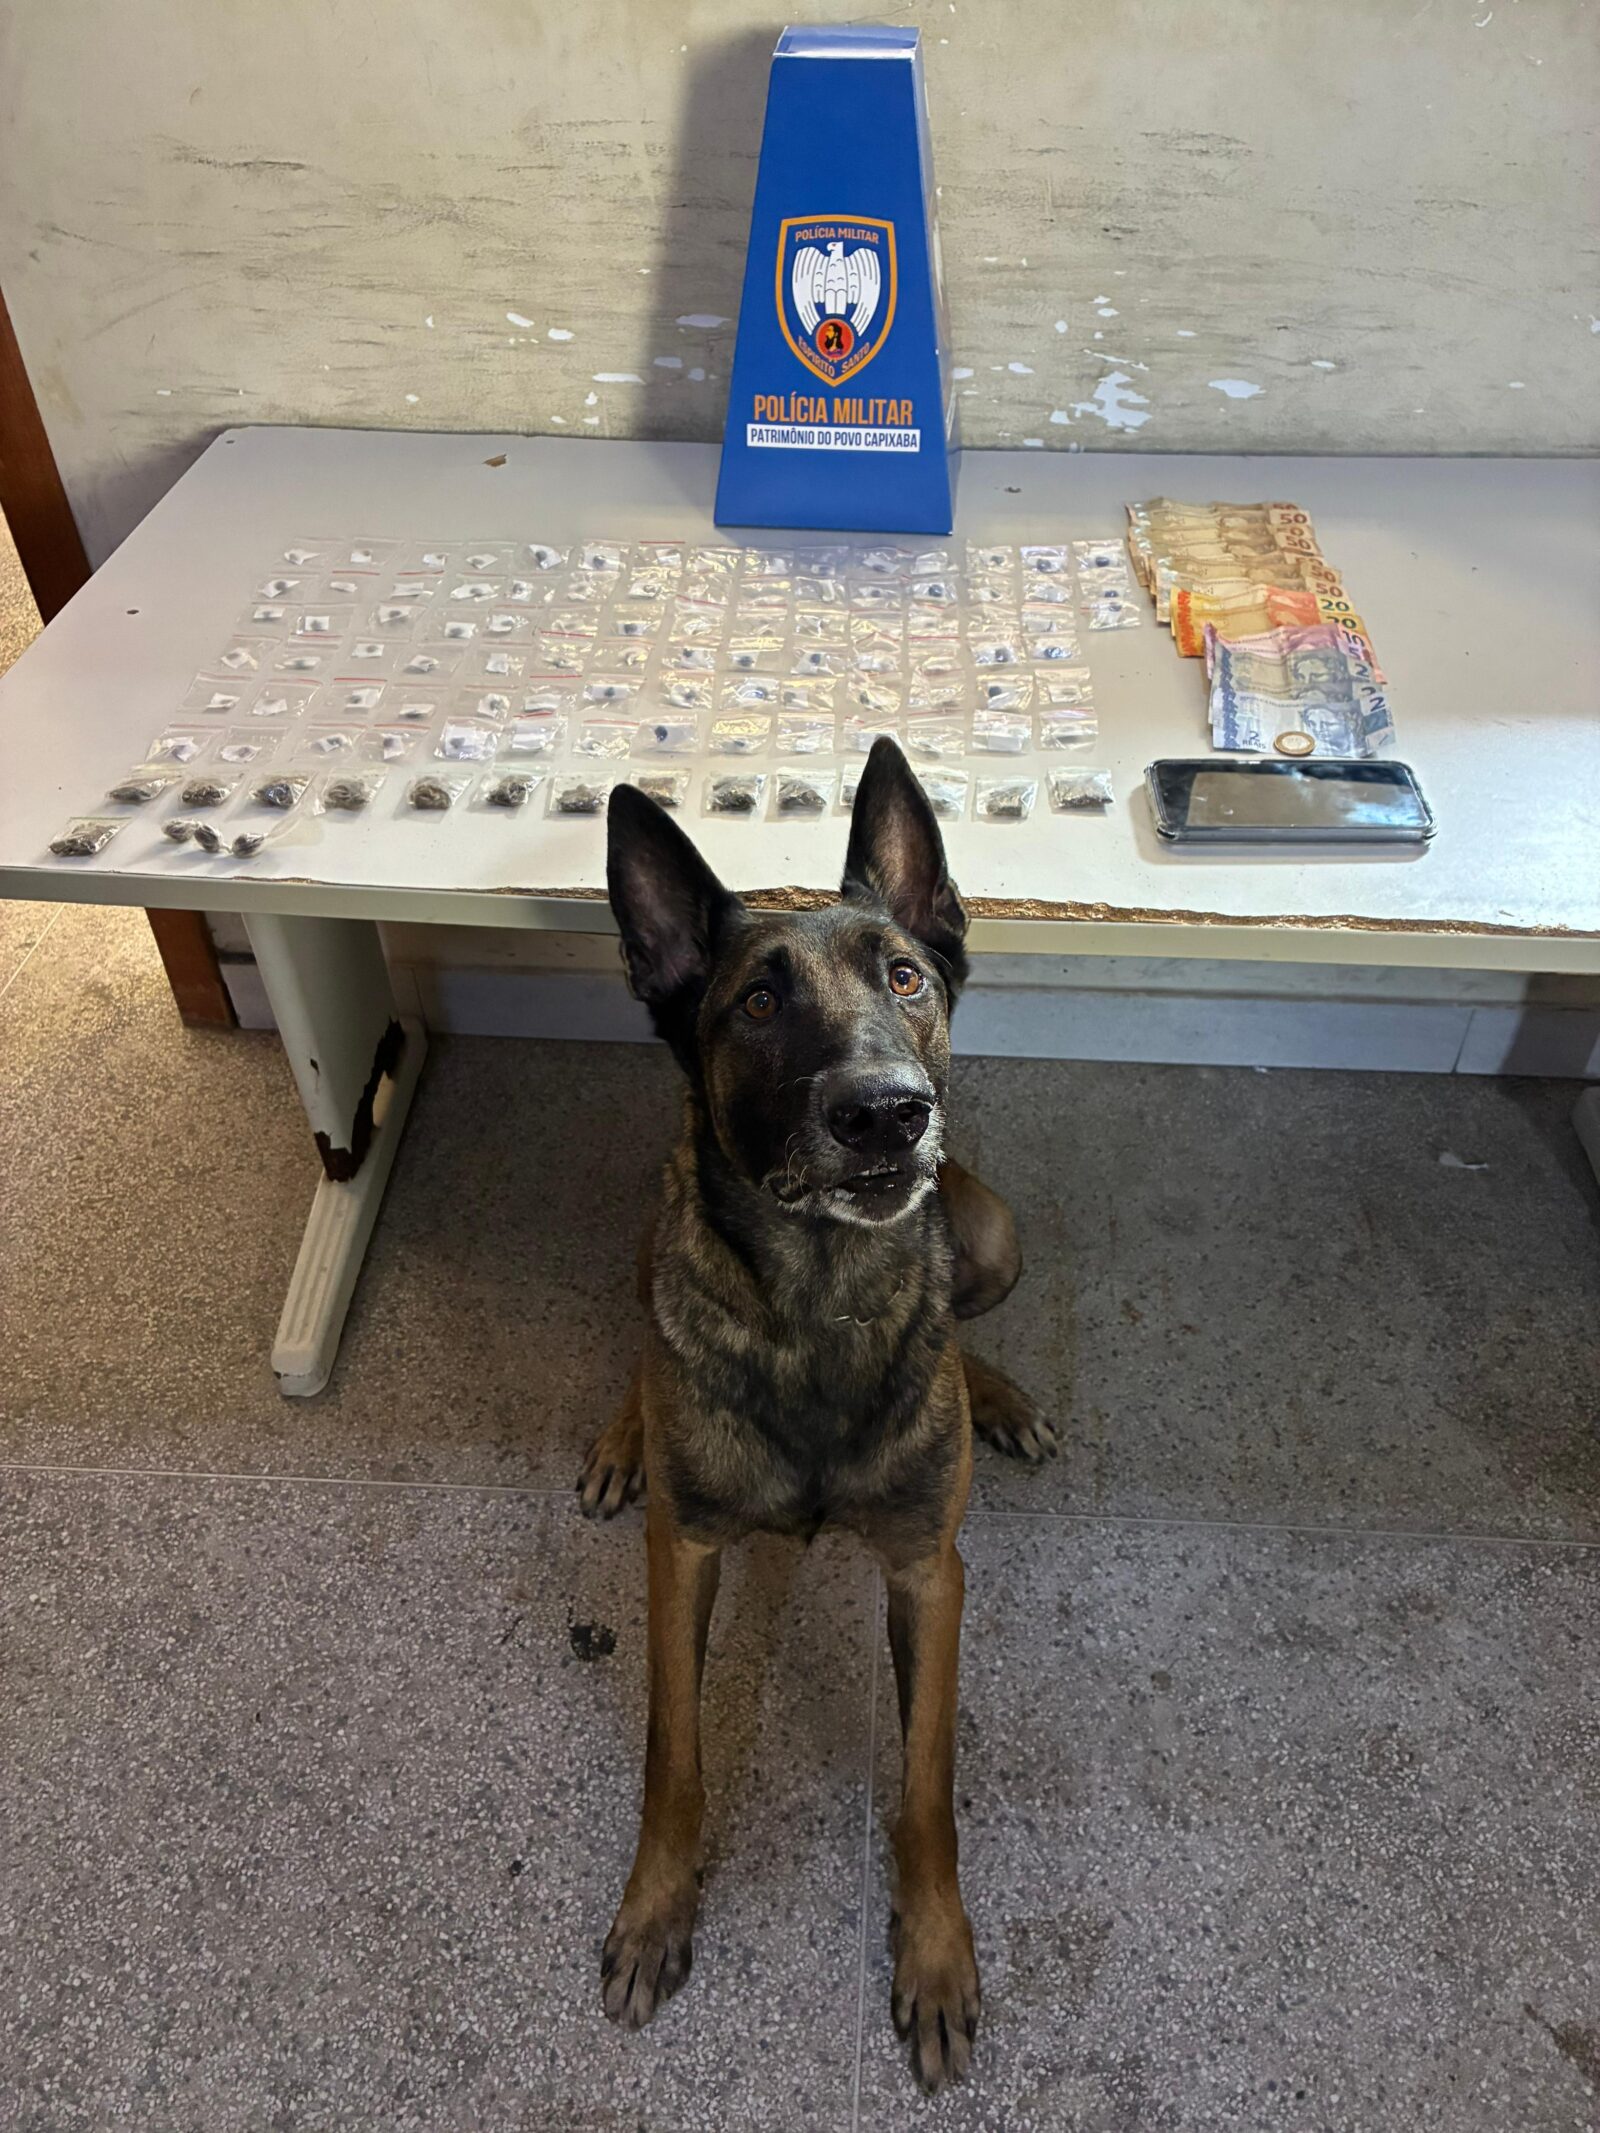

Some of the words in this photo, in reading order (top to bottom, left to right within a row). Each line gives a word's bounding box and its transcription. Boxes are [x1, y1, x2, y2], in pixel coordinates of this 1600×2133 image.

[795, 225, 836, 242] POLÍCIA
[838, 227, 879, 244] MILITAR
[841, 342, 870, 373] SANTO
[754, 391, 828, 424] POLÍCIA
[833, 397, 913, 426] MILITAR
[751, 427, 814, 445] PATRIMÔNIO
[817, 431, 831, 446] DO
[834, 431, 862, 447] POVO
[864, 432, 918, 448] CAPIXABA
[1280, 513, 1307, 525] 50
[1286, 535, 1311, 550] 50
[1311, 564, 1336, 583] 50
[1316, 583, 1343, 598] 50
[1320, 598, 1350, 612] 20
[1355, 663, 1369, 678] 2
[1369, 696, 1386, 712] 2
[1249, 731, 1260, 742] 2
